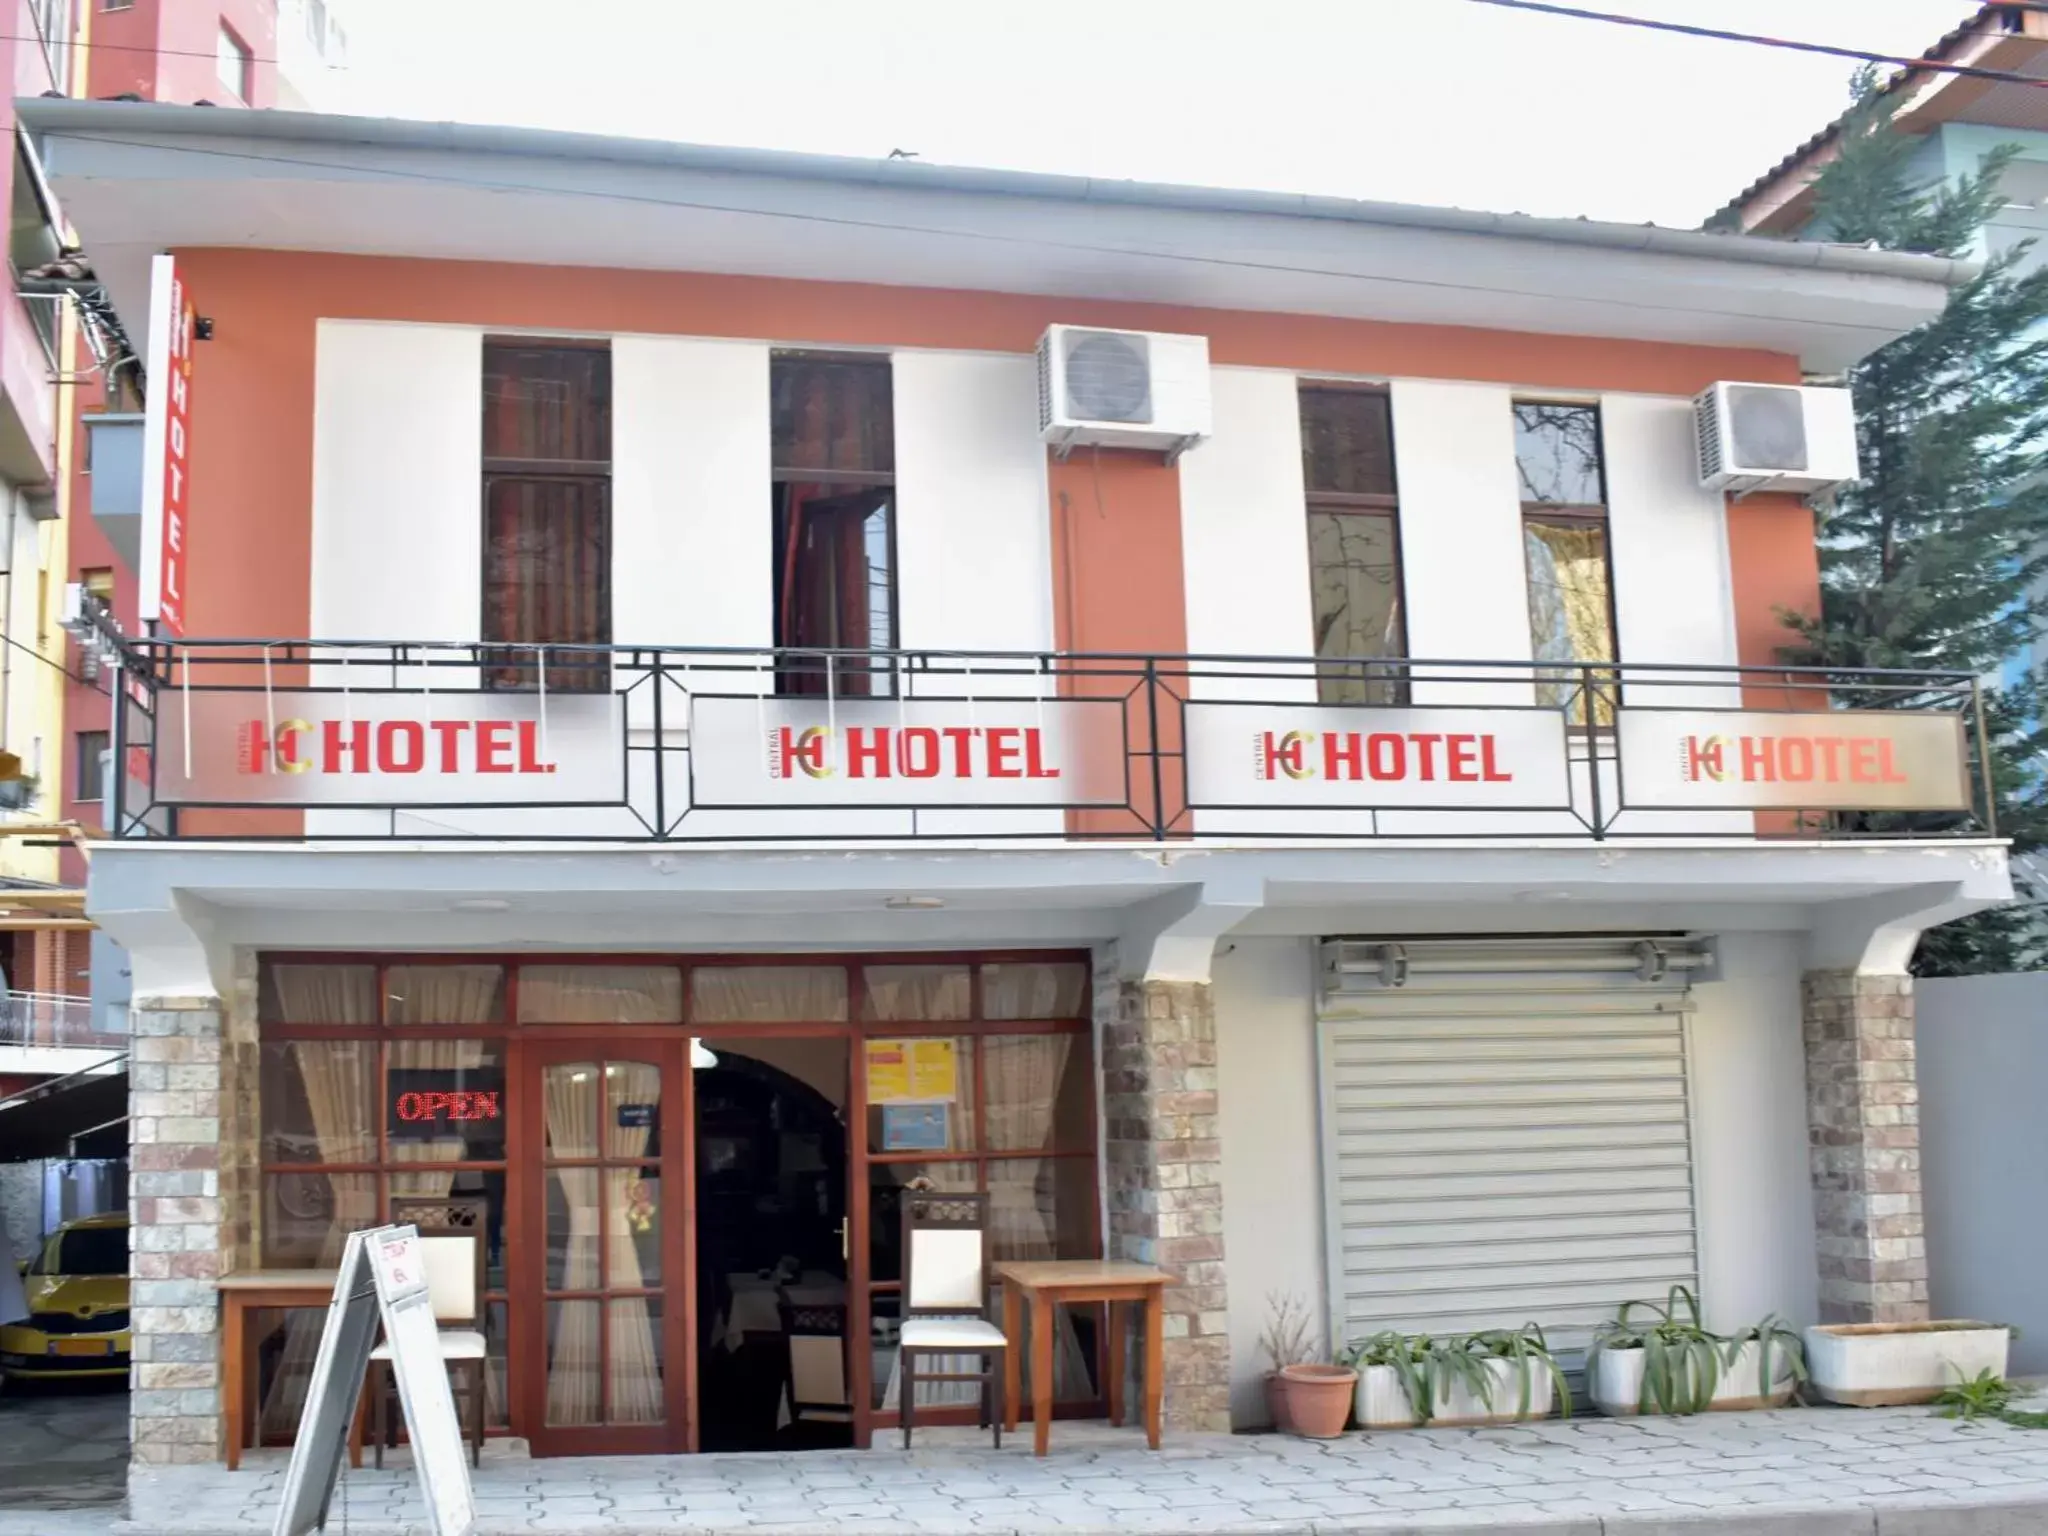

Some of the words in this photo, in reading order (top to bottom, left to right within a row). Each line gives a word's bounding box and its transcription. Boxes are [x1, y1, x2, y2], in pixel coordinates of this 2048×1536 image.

[166, 368, 187, 601] HOTEL
[321, 720, 556, 774] HOTEL
[770, 728, 780, 779] CENTRAL
[846, 727, 1060, 779] HOTEL
[1323, 732, 1513, 782] HOTEL
[1739, 736, 1907, 784] HOTEL
[396, 1091, 499, 1121] OPEN
